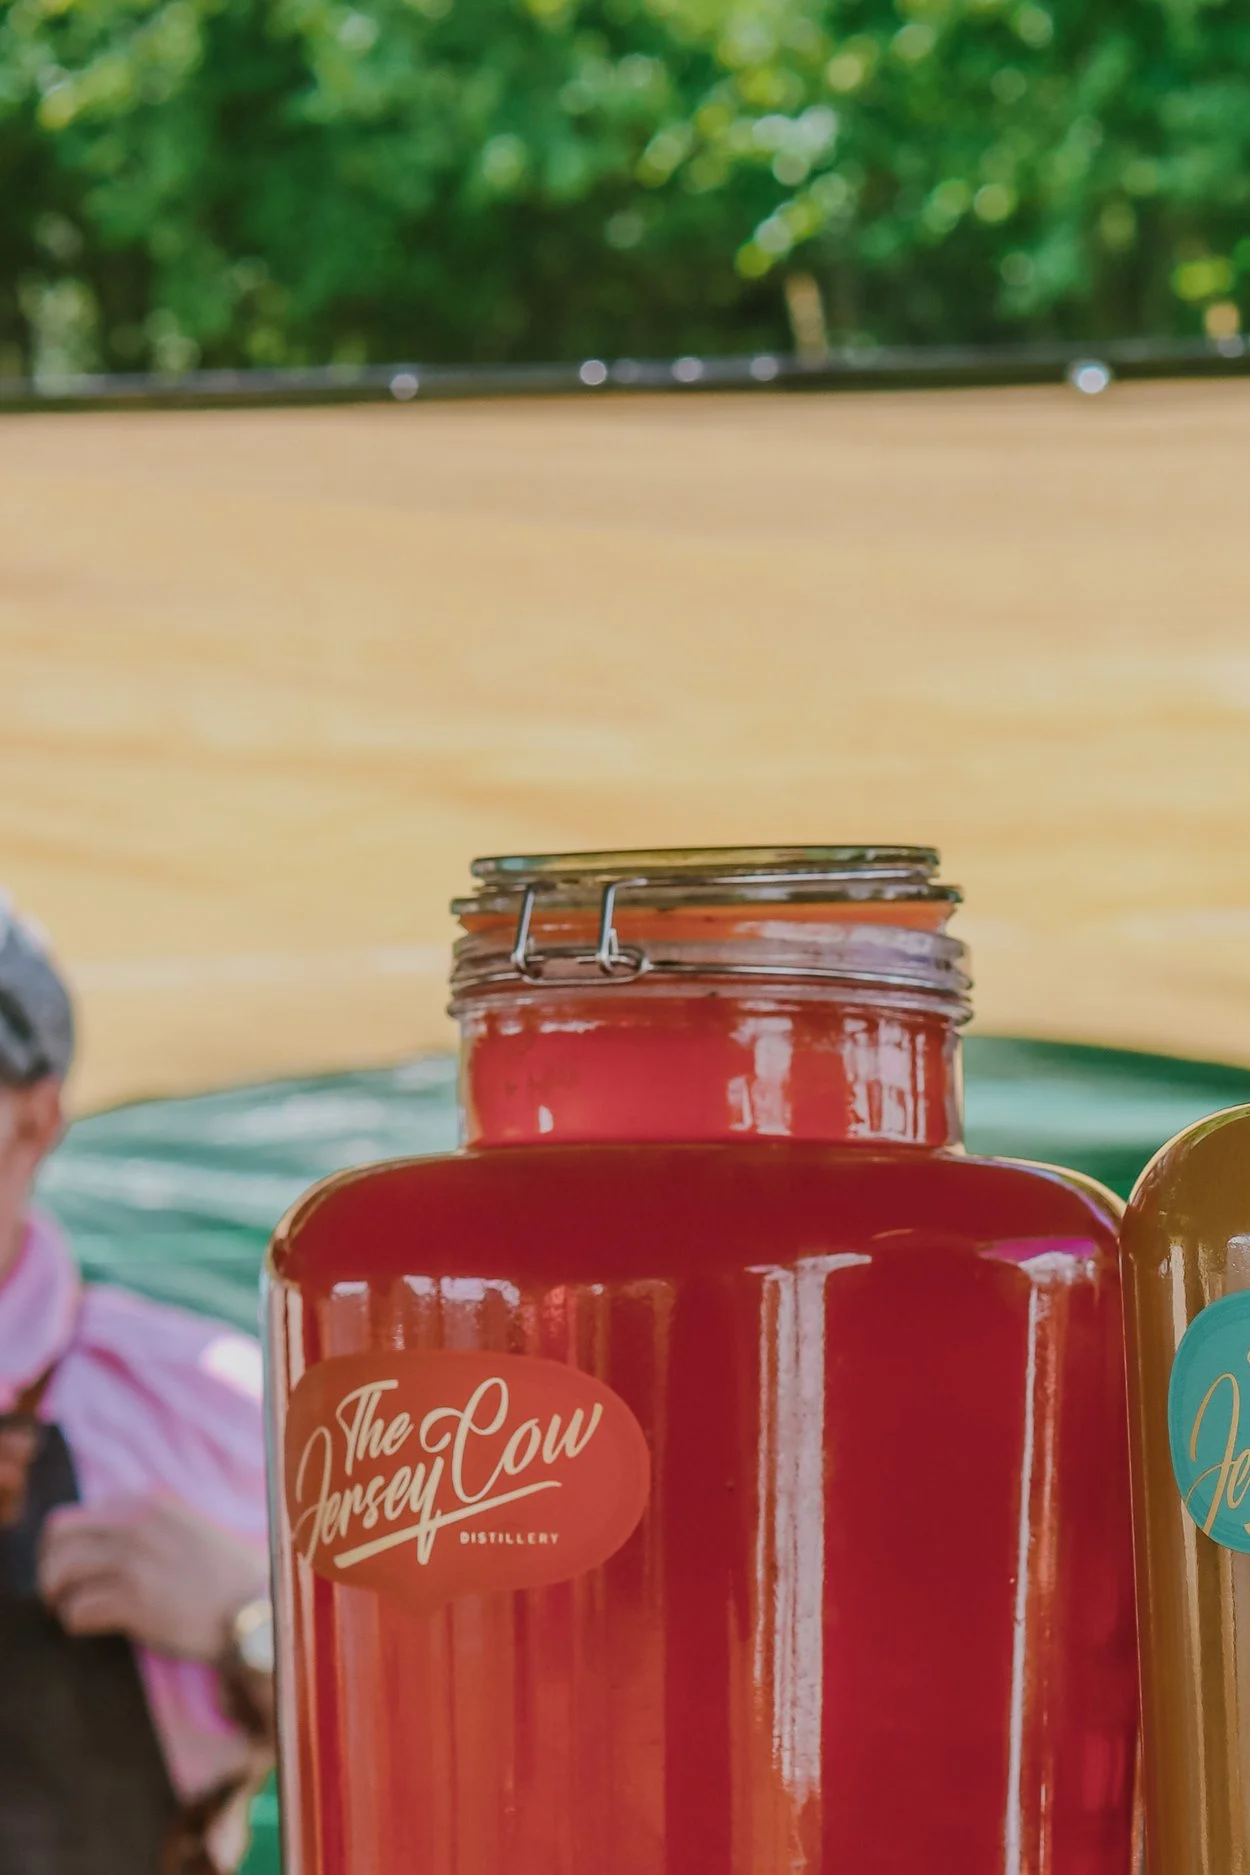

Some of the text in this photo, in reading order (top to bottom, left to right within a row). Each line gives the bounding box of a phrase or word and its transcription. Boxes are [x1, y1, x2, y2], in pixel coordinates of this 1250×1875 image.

[291, 1377, 603, 1566] Jersey Cow
[336, 1379, 414, 1476] The
[460, 1531, 559, 1545] DISTILLERY
